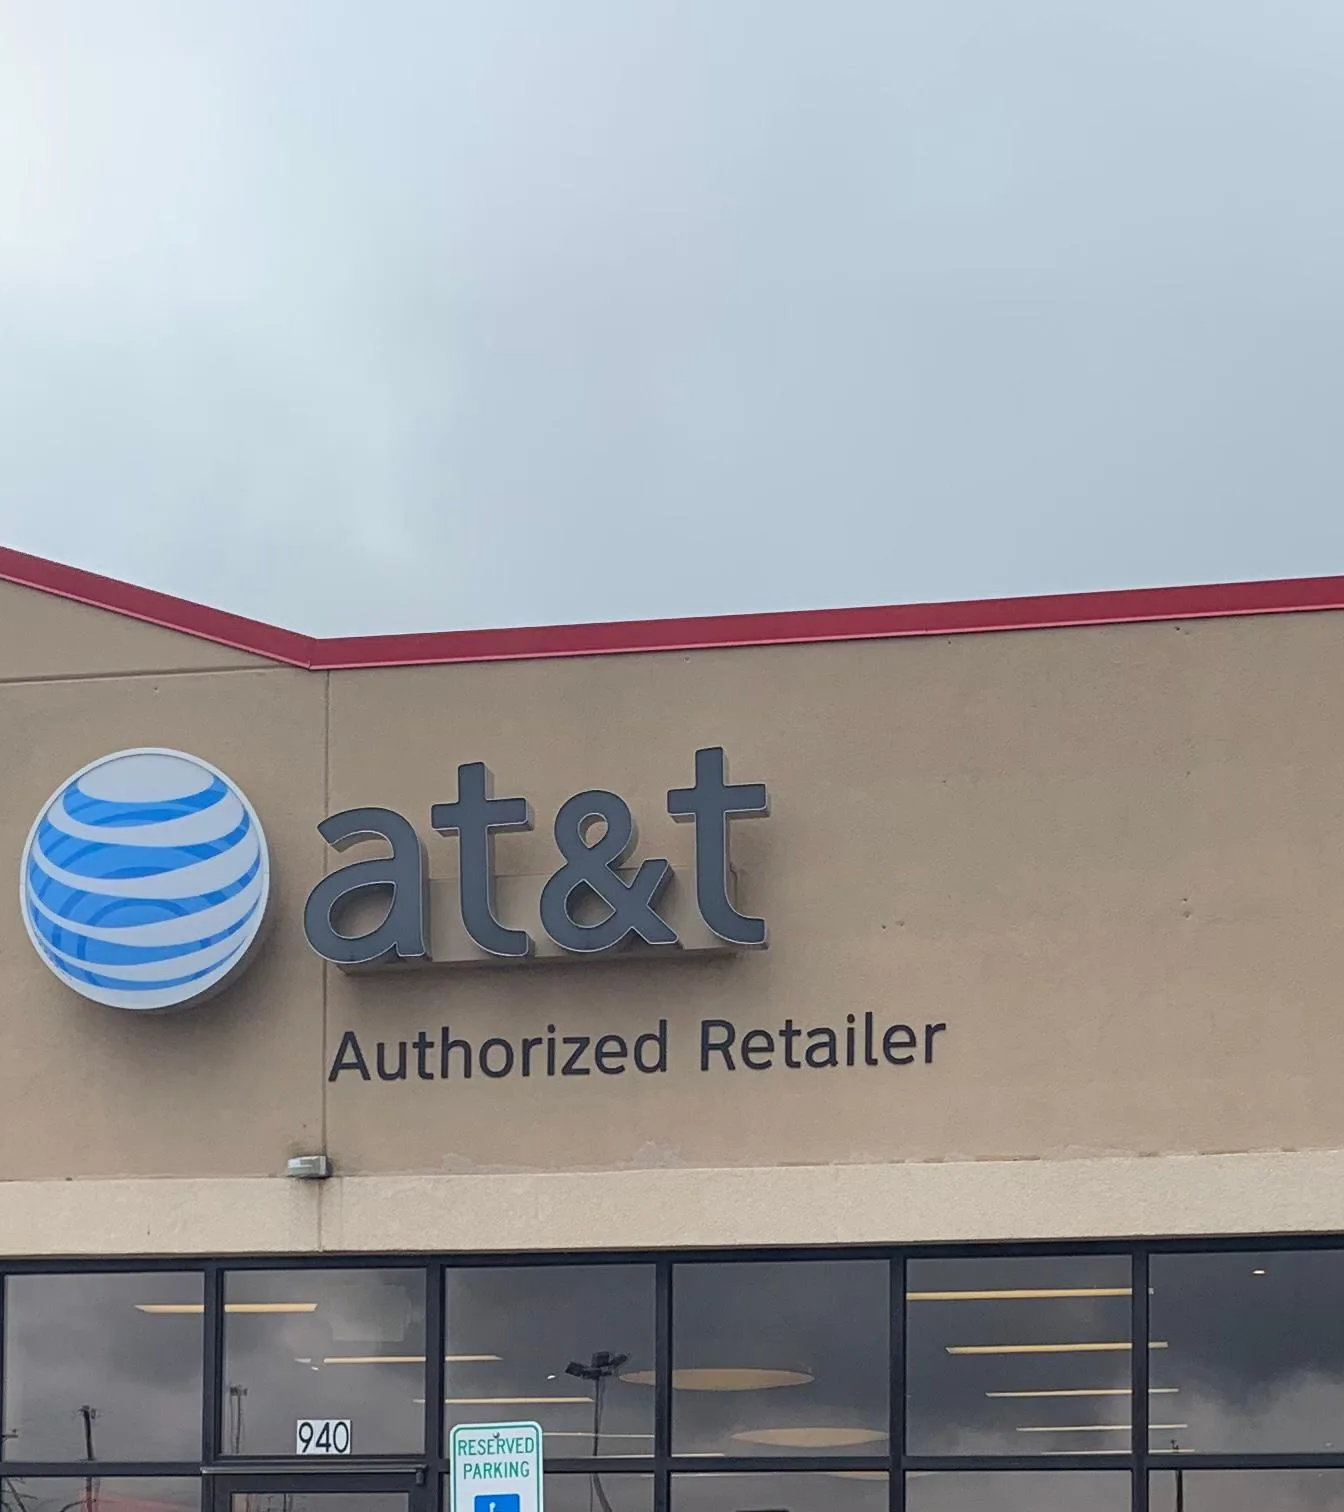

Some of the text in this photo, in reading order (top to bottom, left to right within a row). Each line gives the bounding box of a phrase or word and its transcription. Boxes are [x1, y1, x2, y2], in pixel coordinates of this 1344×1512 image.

[304, 747, 770, 964] at&t
[328, 1012, 947, 1083] Authorized Retailer
[298, 1421, 350, 1454] 940
[457, 1437, 535, 1457] RESERVED
[463, 1460, 530, 1480] PARKING
